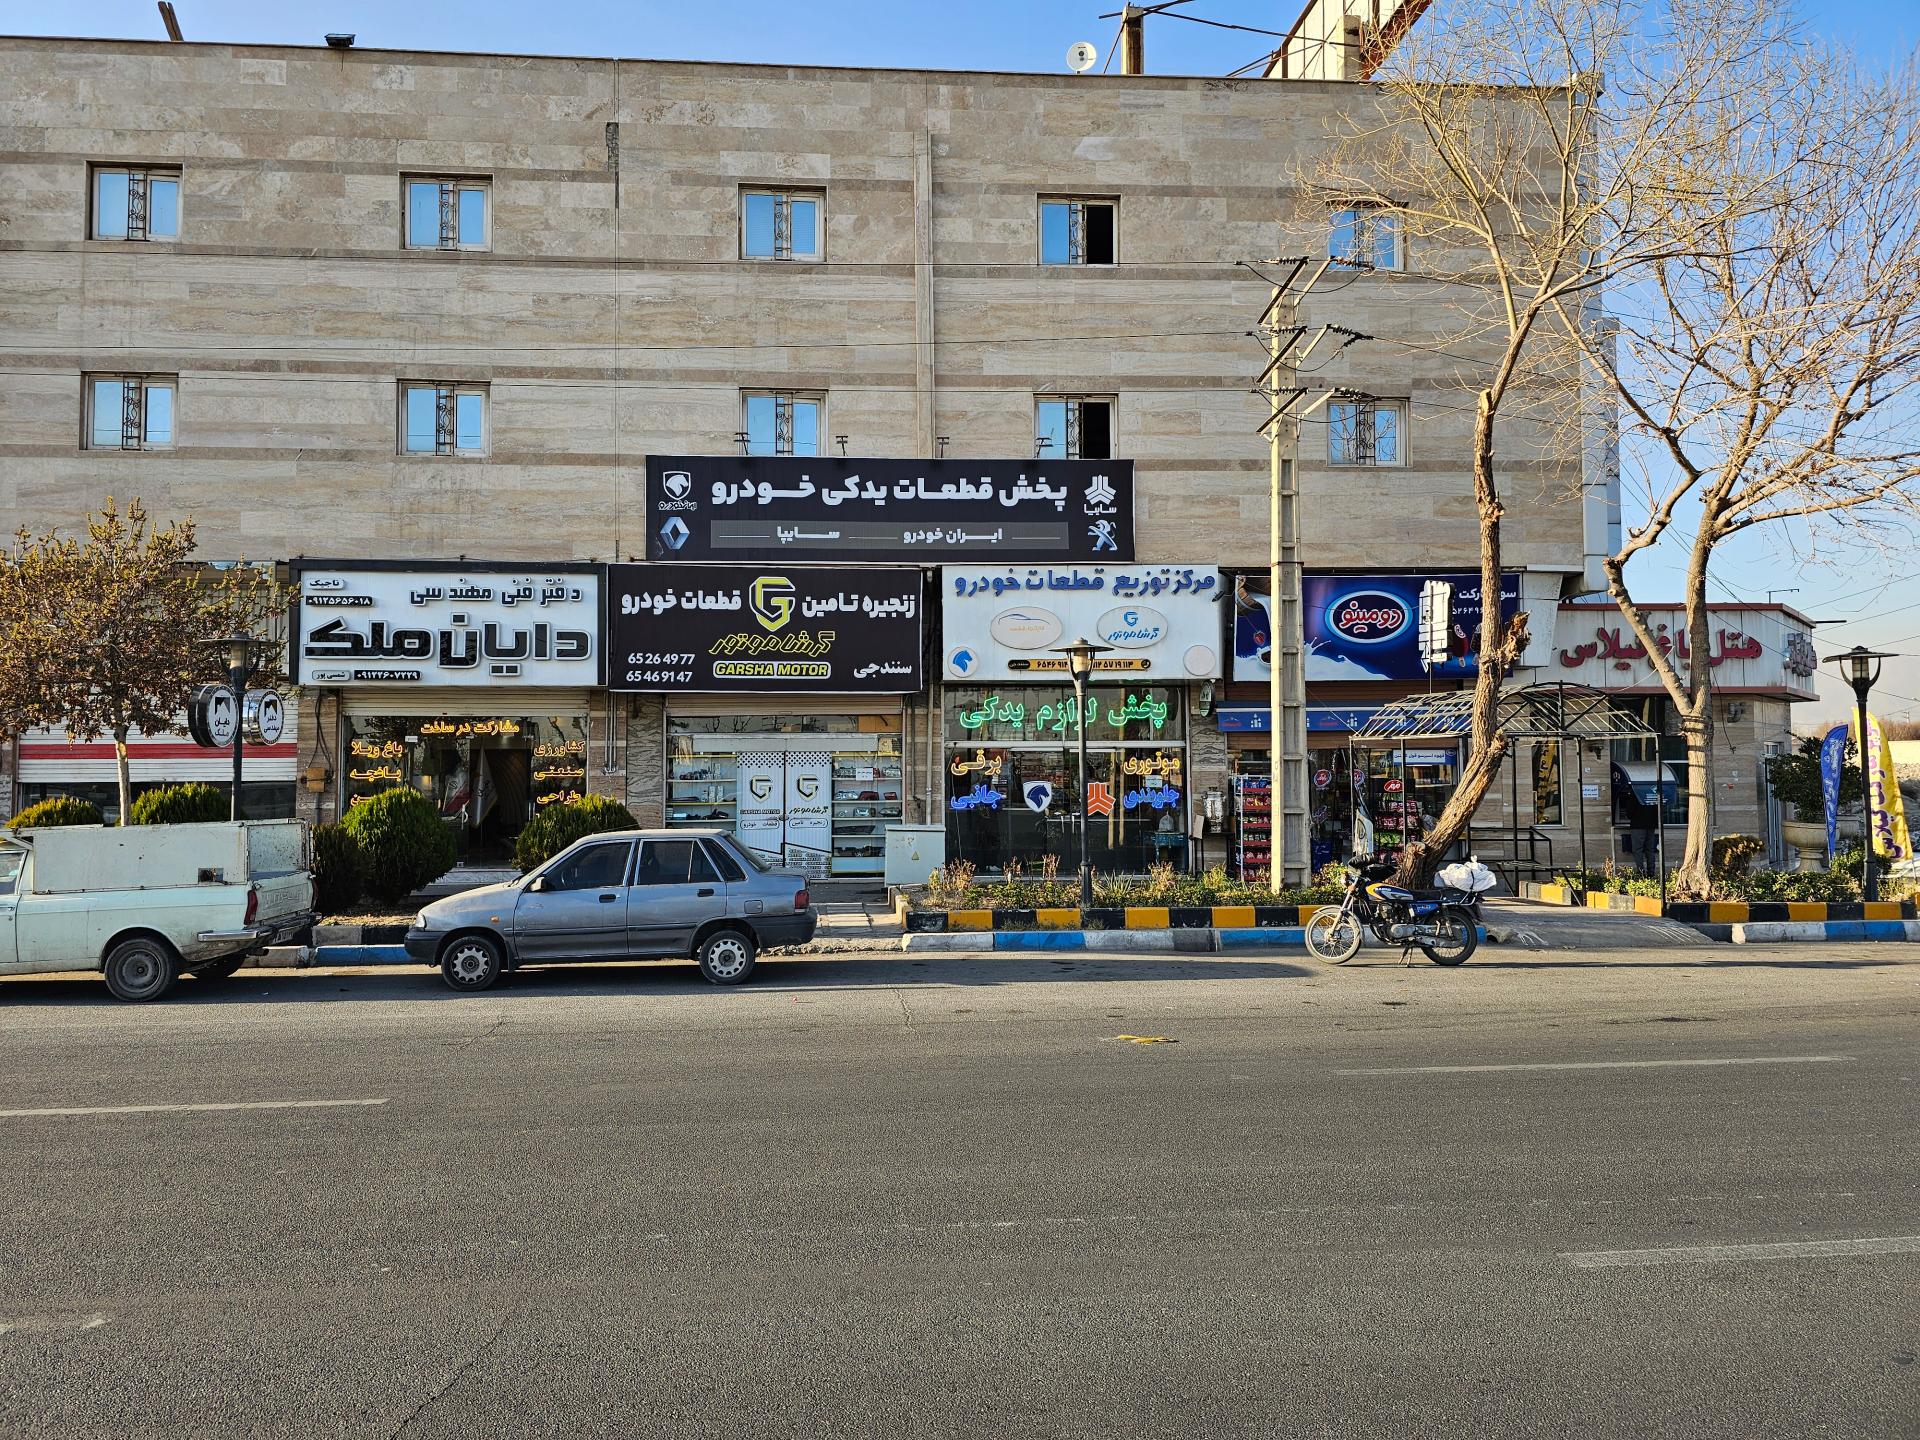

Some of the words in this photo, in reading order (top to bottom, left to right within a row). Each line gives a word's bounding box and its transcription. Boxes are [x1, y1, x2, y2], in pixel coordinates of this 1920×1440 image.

[711, 475, 816, 505] خودرو
[822, 475, 887, 506] یدکی
[894, 476, 994, 503] قطعات
[998, 474, 1067, 511] پخش
[777, 526, 840, 544] سایپا
[903, 528, 943, 544] خودرو
[946, 528, 1003, 543] ایران
[410, 577, 493, 606] مهندسی
[502, 577, 533, 605] فنی
[540, 577, 582, 606] دفتر
[954, 568, 1021, 597] خودرو
[1025, 568, 1105, 591] قطعات
[1112, 568, 1170, 597] توزیع
[1171, 569, 1215, 596] مرکز
[622, 589, 678, 615] خودرو
[681, 590, 742, 610] قطعات
[802, 593, 858, 617] تامین
[862, 594, 916, 618] زنجیره
[1339, 601, 1402, 633] دومینو
[303, 616, 434, 659] ملک
[438, 613, 591, 676] دایان
[1708, 628, 1763, 667] هتل
[716, 662, 775, 676] GARSHA
[777, 663, 829, 676] MOTOR
[853, 661, 912, 678] سنندجی
[959, 696, 1025, 728] یدکی
[1108, 694, 1167, 728] پخش
[421, 720, 455, 735] ساخت
[455, 723, 471, 736] در
[473, 719, 519, 735] مشارکت
[382, 741, 402, 758] باغ
[533, 741, 586, 756] کشاورزی
[533, 766, 585, 780] صنعتی
[951, 749, 1002, 775] برقی
[1124, 752, 1180, 775] موتوری
[537, 790, 581, 804] طراحی
[951, 784, 1002, 809] جانبی
